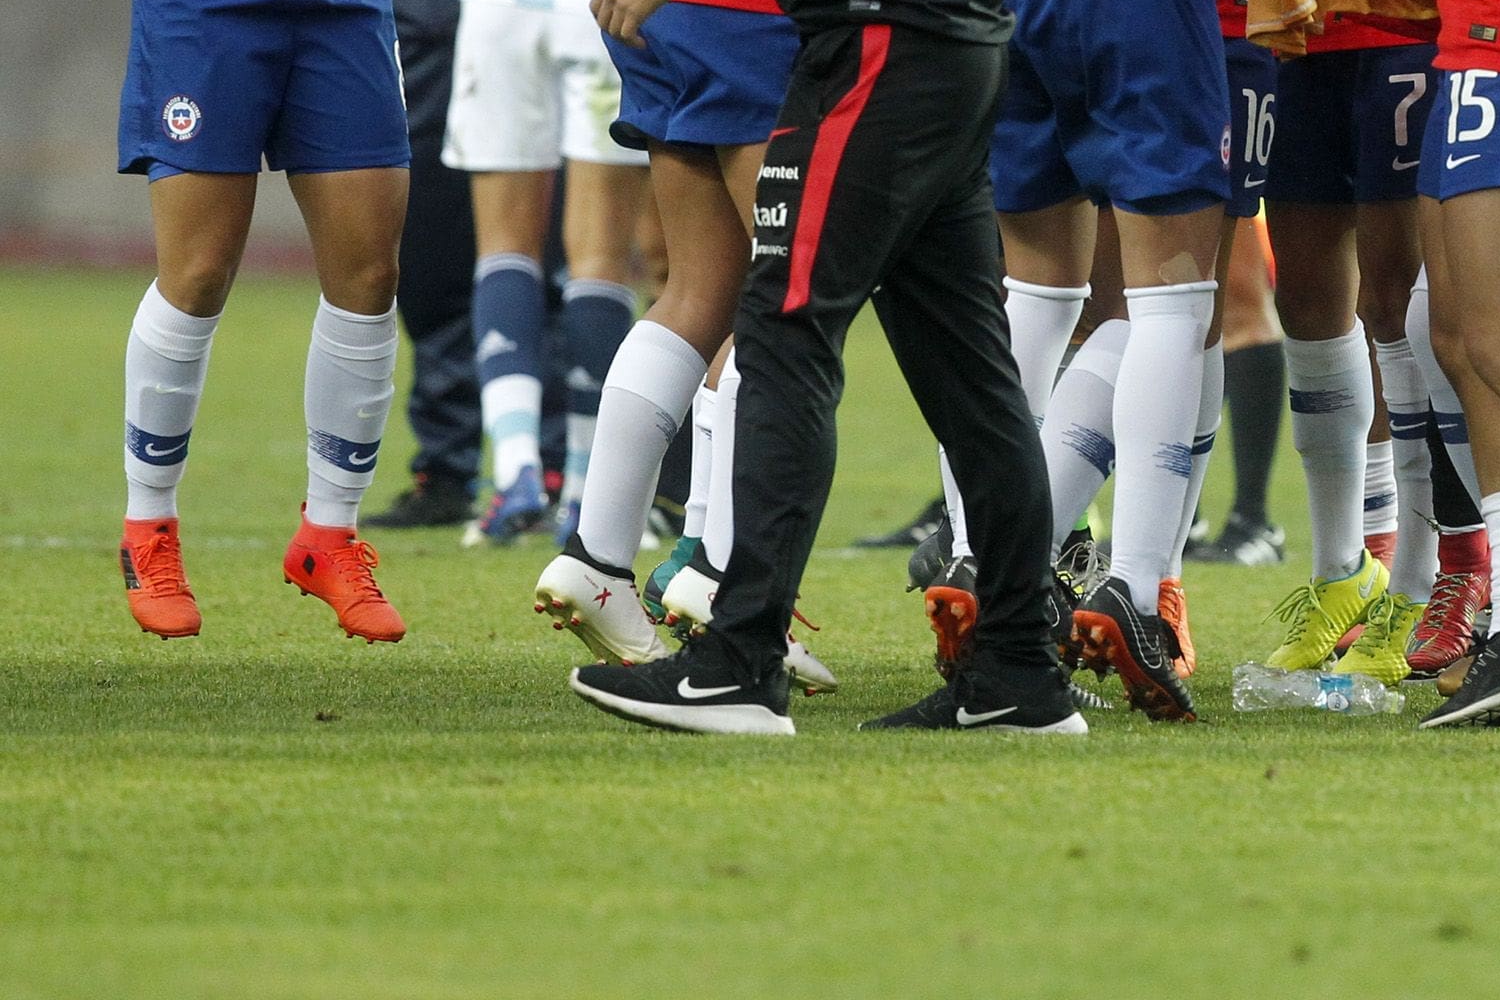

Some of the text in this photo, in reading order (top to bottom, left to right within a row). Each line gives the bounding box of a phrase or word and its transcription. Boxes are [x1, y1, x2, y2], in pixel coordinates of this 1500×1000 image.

[1242, 88, 1275, 166] 16
[1388, 72, 1426, 146] 7
[1447, 68, 1498, 144] 15
[762, 165, 799, 180] entel
[753, 202, 788, 227] taú
